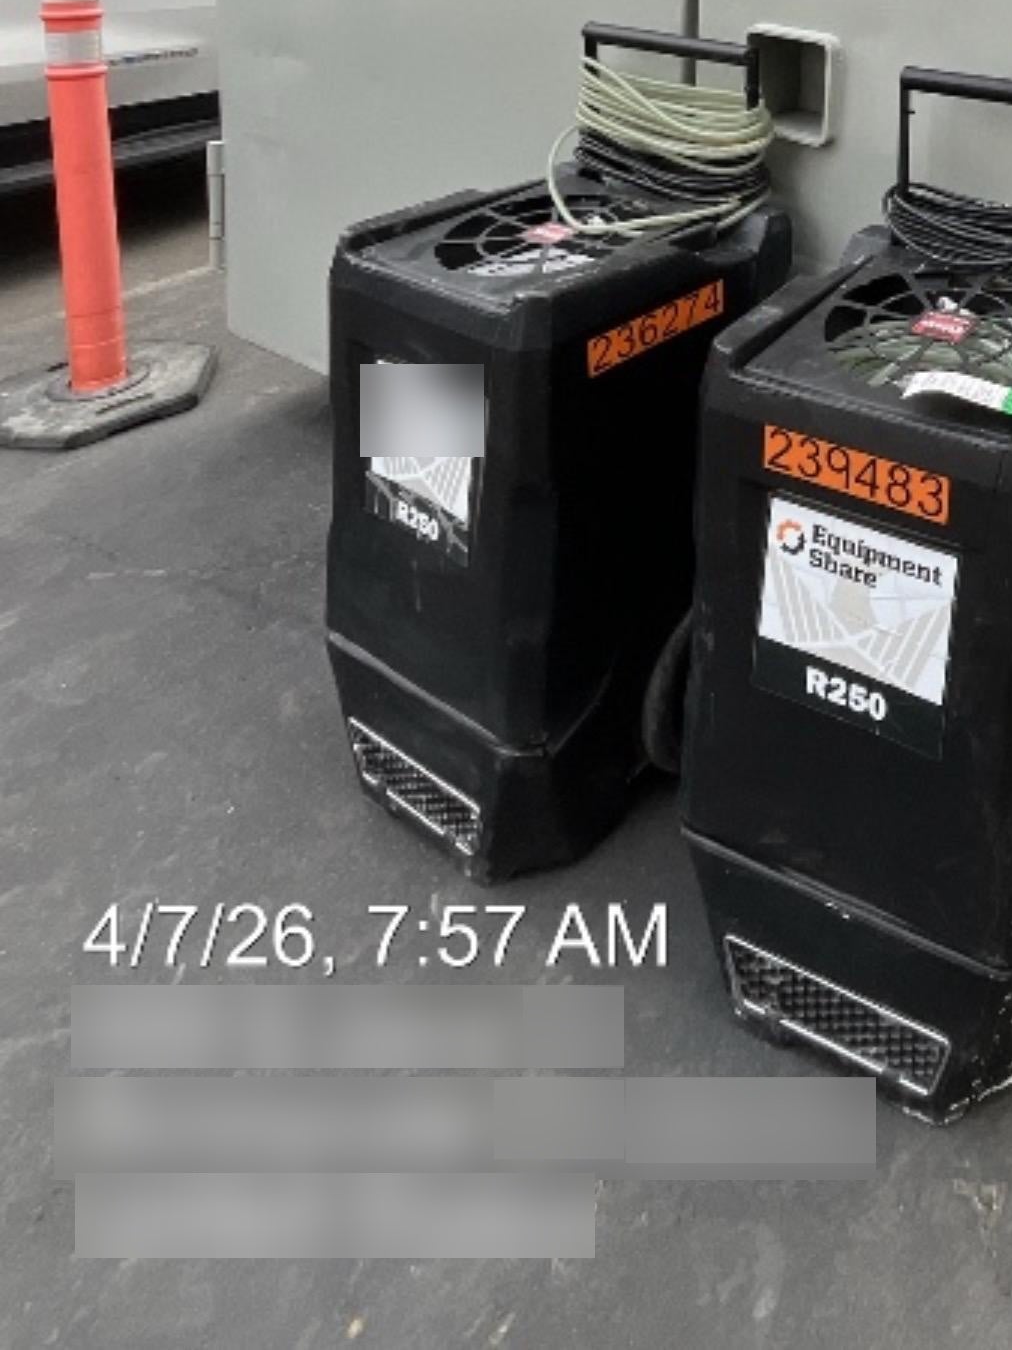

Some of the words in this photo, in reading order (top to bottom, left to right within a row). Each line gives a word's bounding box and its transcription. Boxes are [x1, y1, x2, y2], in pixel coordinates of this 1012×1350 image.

[593, 286, 723, 374] 236274
[767, 429, 946, 519] 239483
[808, 548, 877, 589] Share
[811, 523, 943, 587] Equipment
[806, 666, 889, 722] R250
